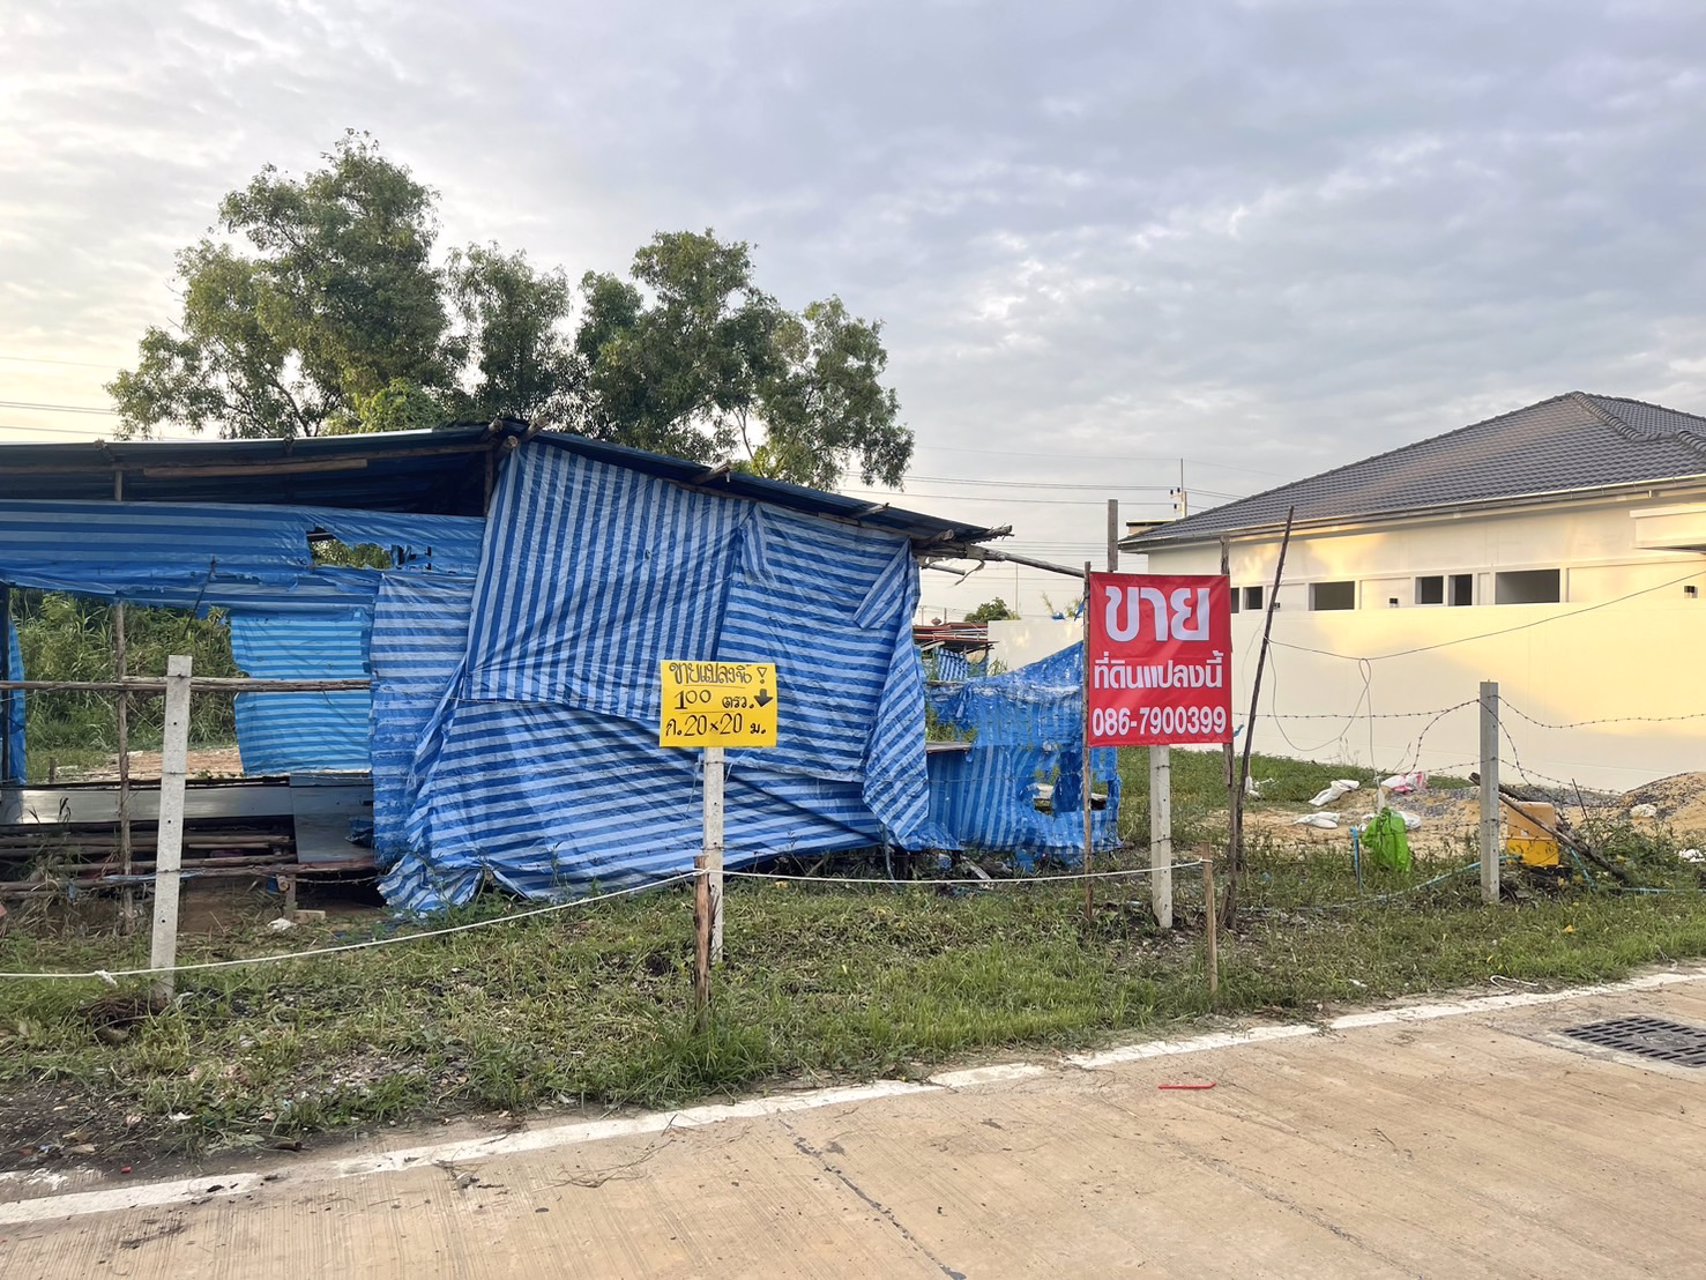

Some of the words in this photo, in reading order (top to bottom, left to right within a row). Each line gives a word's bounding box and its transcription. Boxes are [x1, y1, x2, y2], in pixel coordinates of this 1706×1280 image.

[1105, 585, 1211, 642] ขาย
[1094, 650, 1224, 689] ที่ดินแปลงนี้
[674, 689, 711, 710] 100
[1092, 706, 1227, 737] 086-7900399
